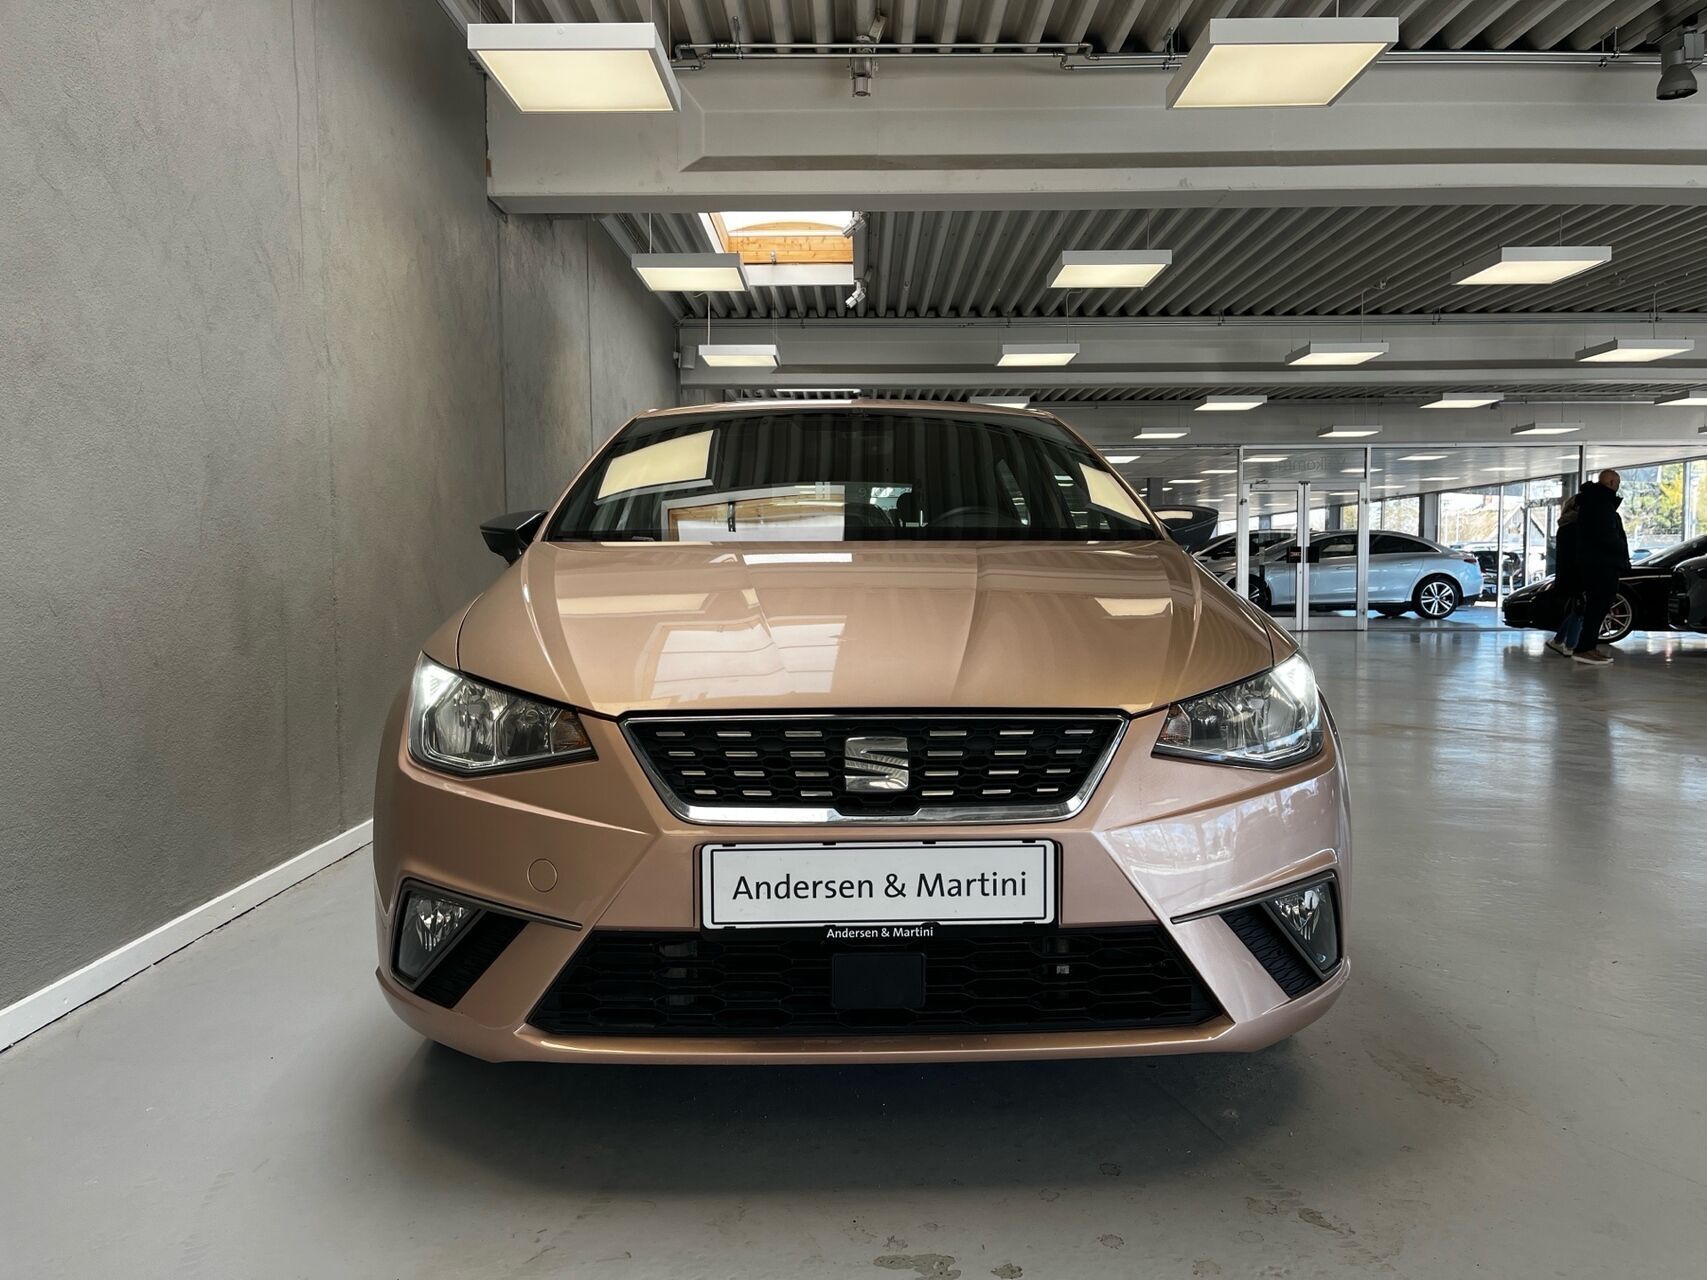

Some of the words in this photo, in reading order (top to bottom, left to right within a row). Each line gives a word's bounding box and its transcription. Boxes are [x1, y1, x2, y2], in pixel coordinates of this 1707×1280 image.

[732, 873, 875, 900] Andersen
[884, 873, 907, 898] &
[916, 871, 1027, 898] Martini
[826, 927, 879, 939] Andersen
[881, 927, 890, 938] &
[892, 926, 934, 938] Martini
